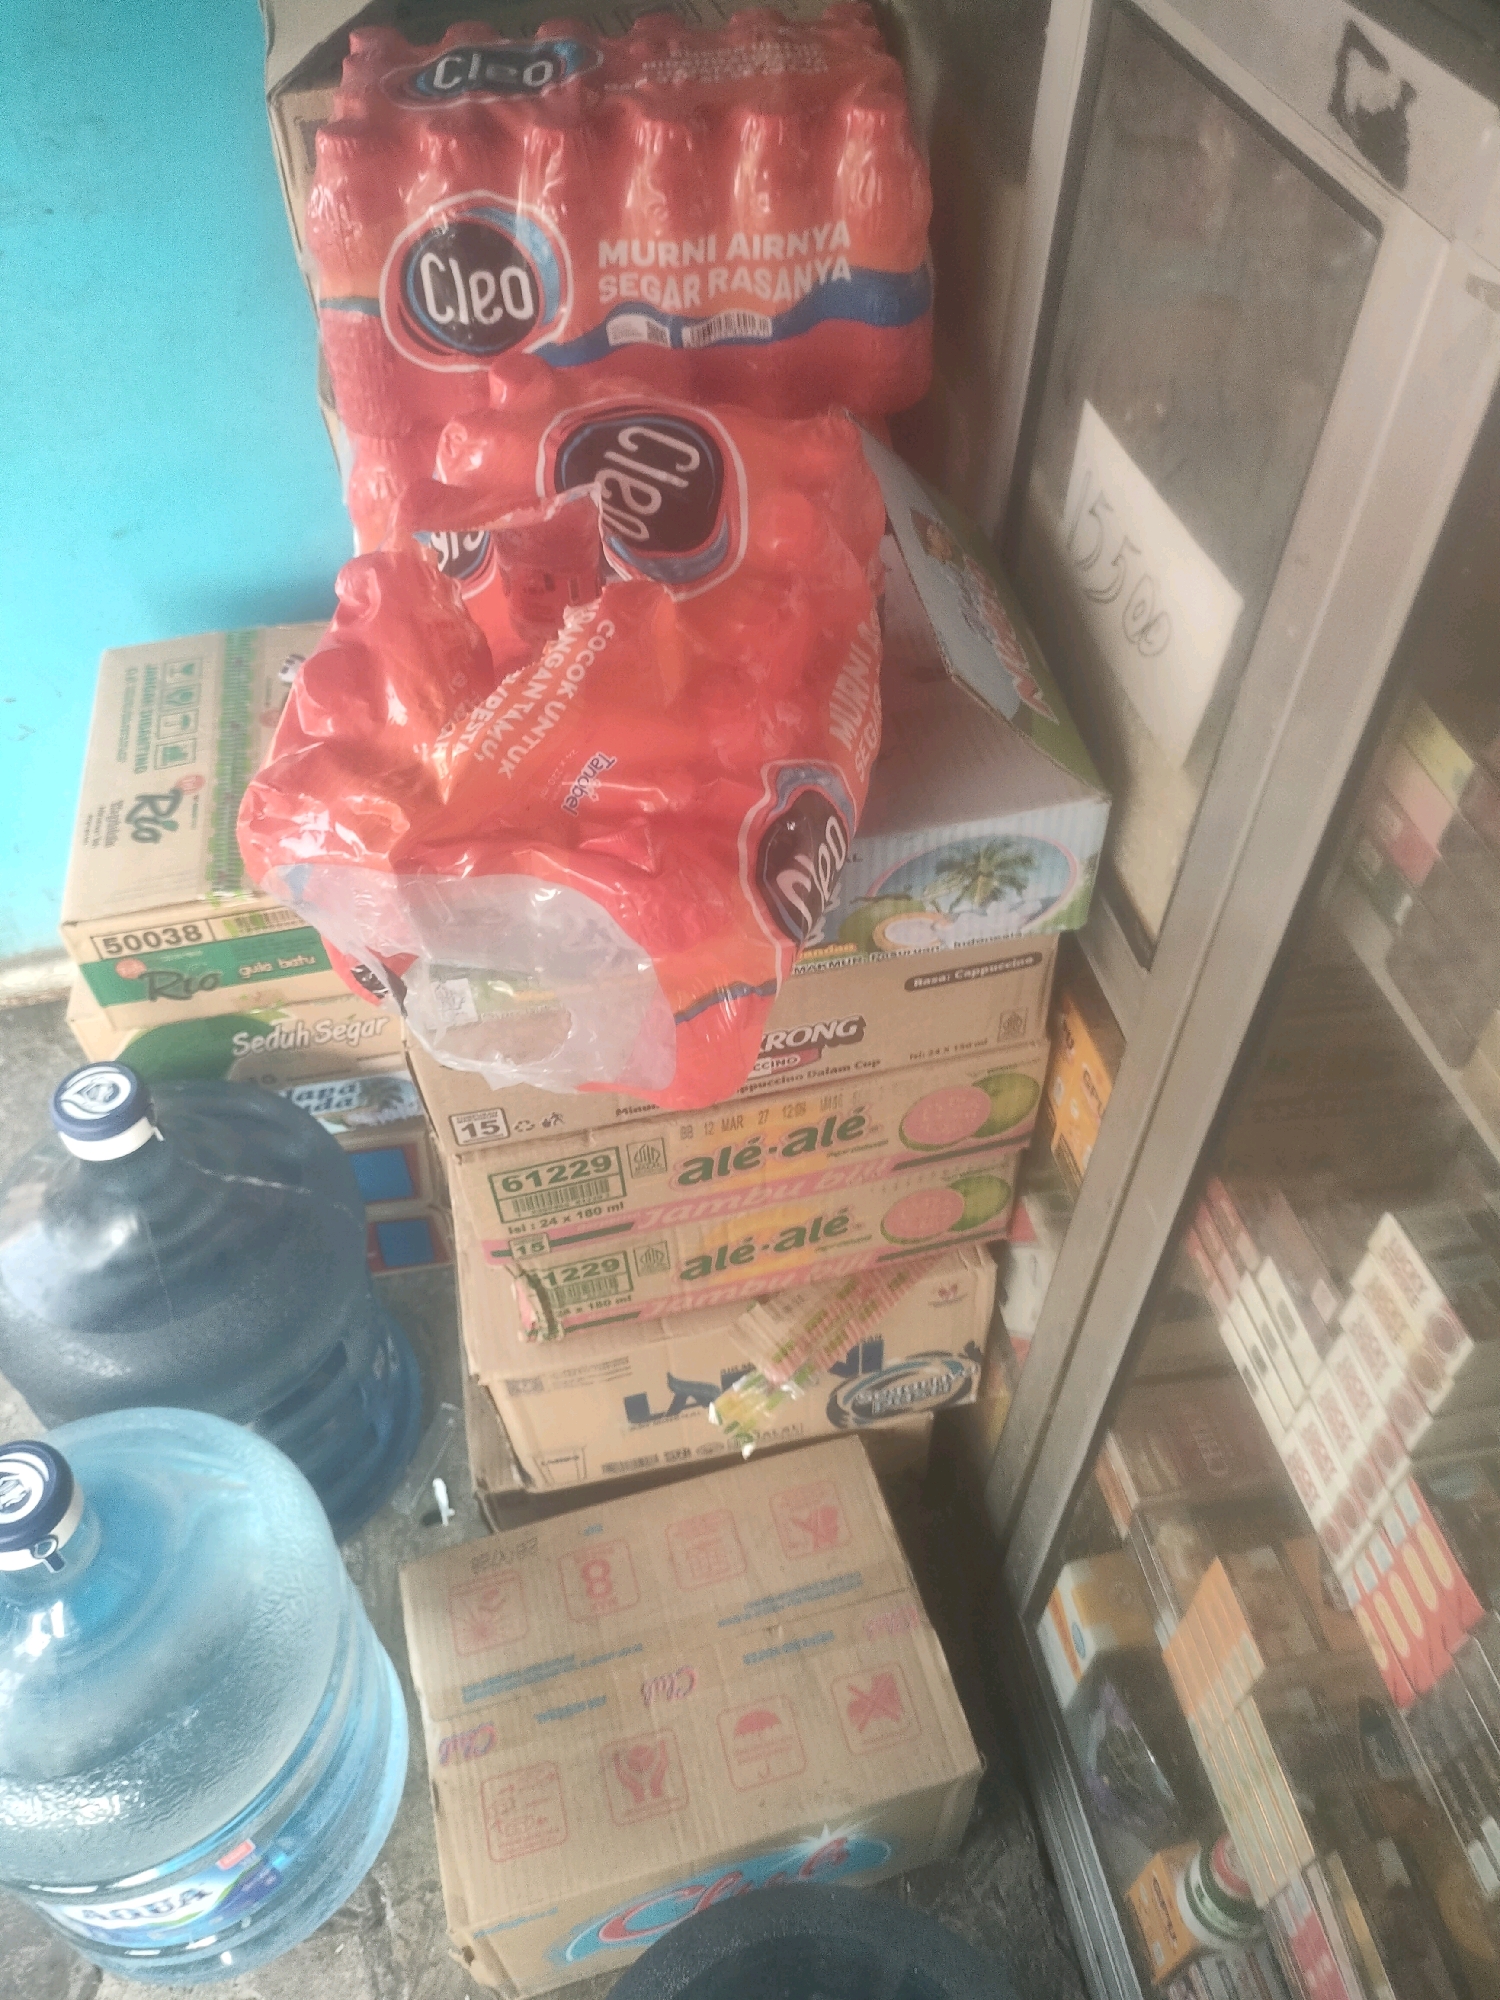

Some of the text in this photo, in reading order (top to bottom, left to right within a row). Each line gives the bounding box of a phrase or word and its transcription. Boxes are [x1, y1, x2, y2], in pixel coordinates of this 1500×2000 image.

[599, 220, 851, 269] MURNI AIRNYA
[420, 252, 534, 325] Cleo
[598, 256, 851, 310] SEGAR RASANYA
[594, 426, 700, 542] Cleo
[498, 619, 616, 780] COCOK UNTUK
[562, 751, 616, 816] Tanobel
[125, 786, 183, 844] Rio
[776, 815, 847, 933] Cleo
[103, 924, 203, 955] 50038
[139, 969, 223, 1002] Rio
[238, 955, 316, 979] gula batu
[954, 956, 1034, 979] Cappuccino
[232, 1016, 389, 1057] Seduh Segar
[461, 1119, 501, 1139] 15
[721, 1115, 744, 1132] MAR
[501, 1154, 613, 1194] 61229
[540, 1218, 558, 1229] 24
[516, 1241, 545, 1255] 15
[640, 1664, 697, 1708] Club
[438, 1721, 497, 1767] Club
